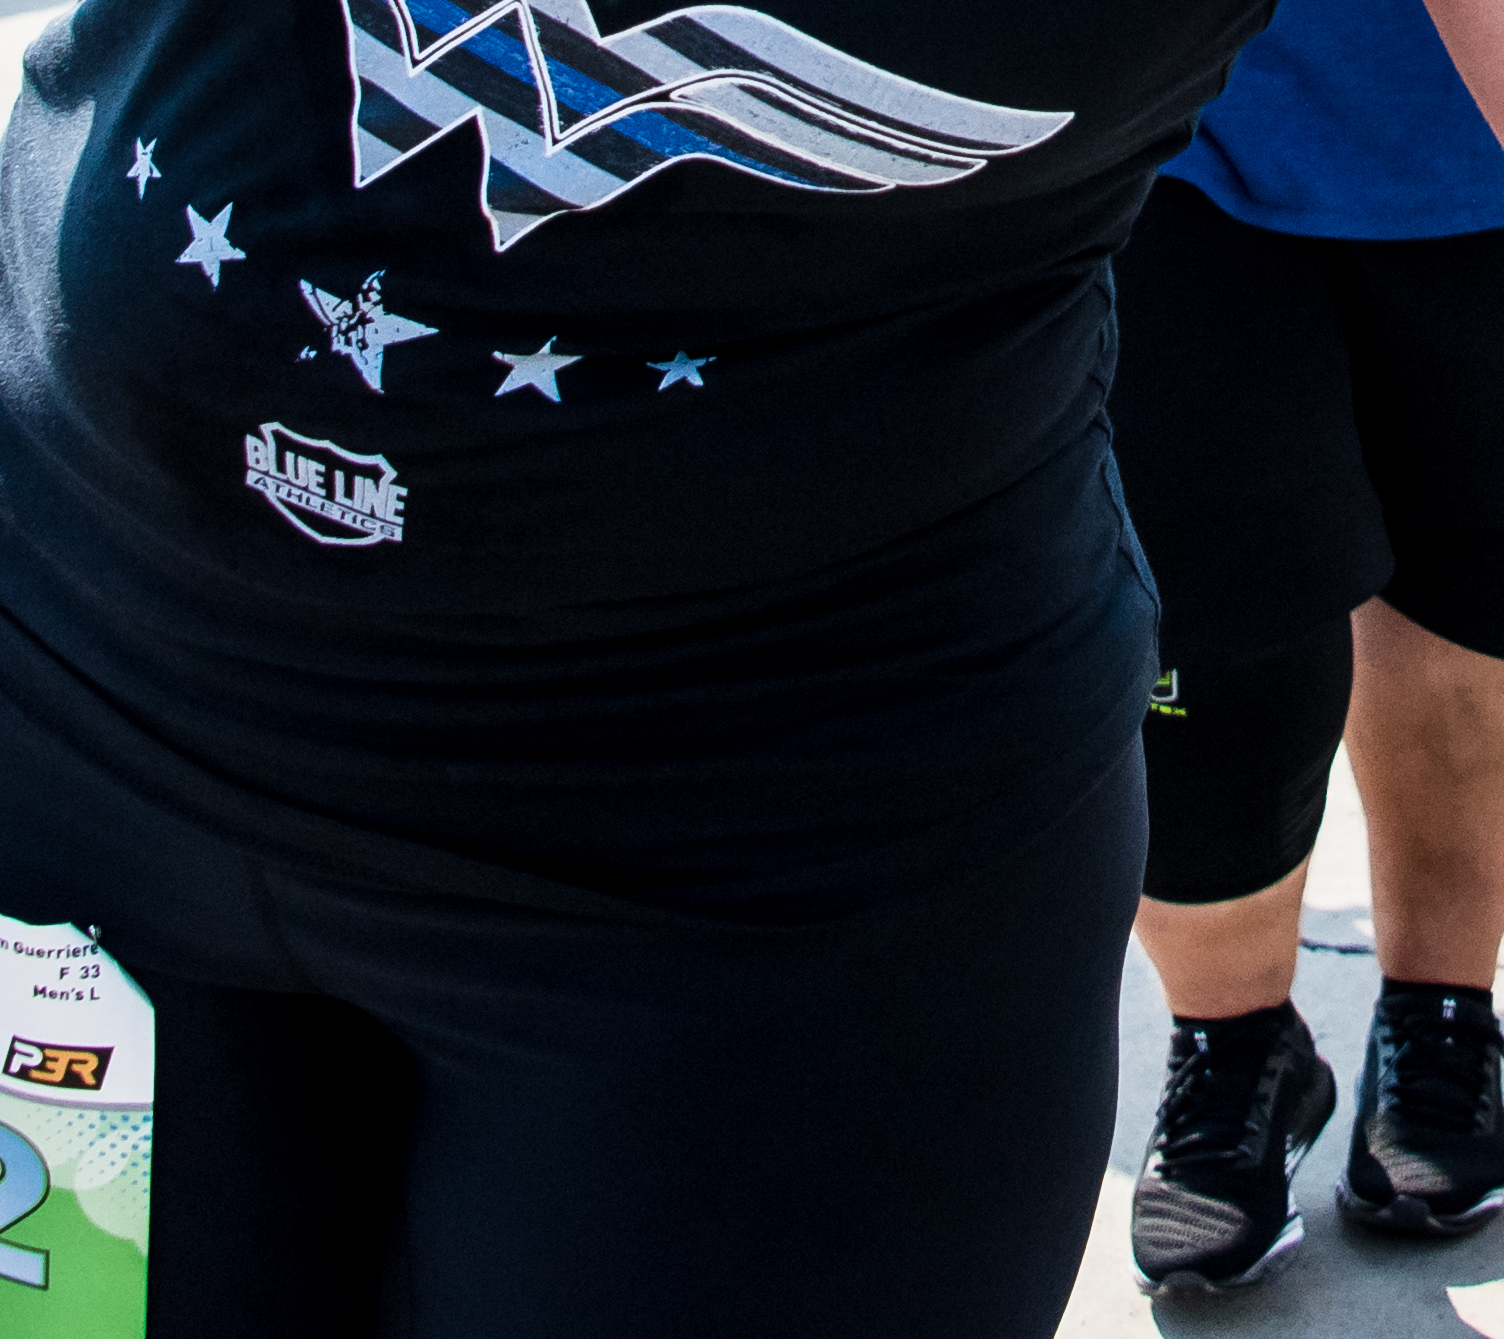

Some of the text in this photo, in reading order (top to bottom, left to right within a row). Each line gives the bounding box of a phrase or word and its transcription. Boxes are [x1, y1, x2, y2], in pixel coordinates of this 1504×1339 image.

[245, 433, 408, 525] BLUE LINE
[253, 476, 397, 538] ATHLETICS
[59, 964, 101, 981] F 33
[33, 984, 101, 1001] Men's L
